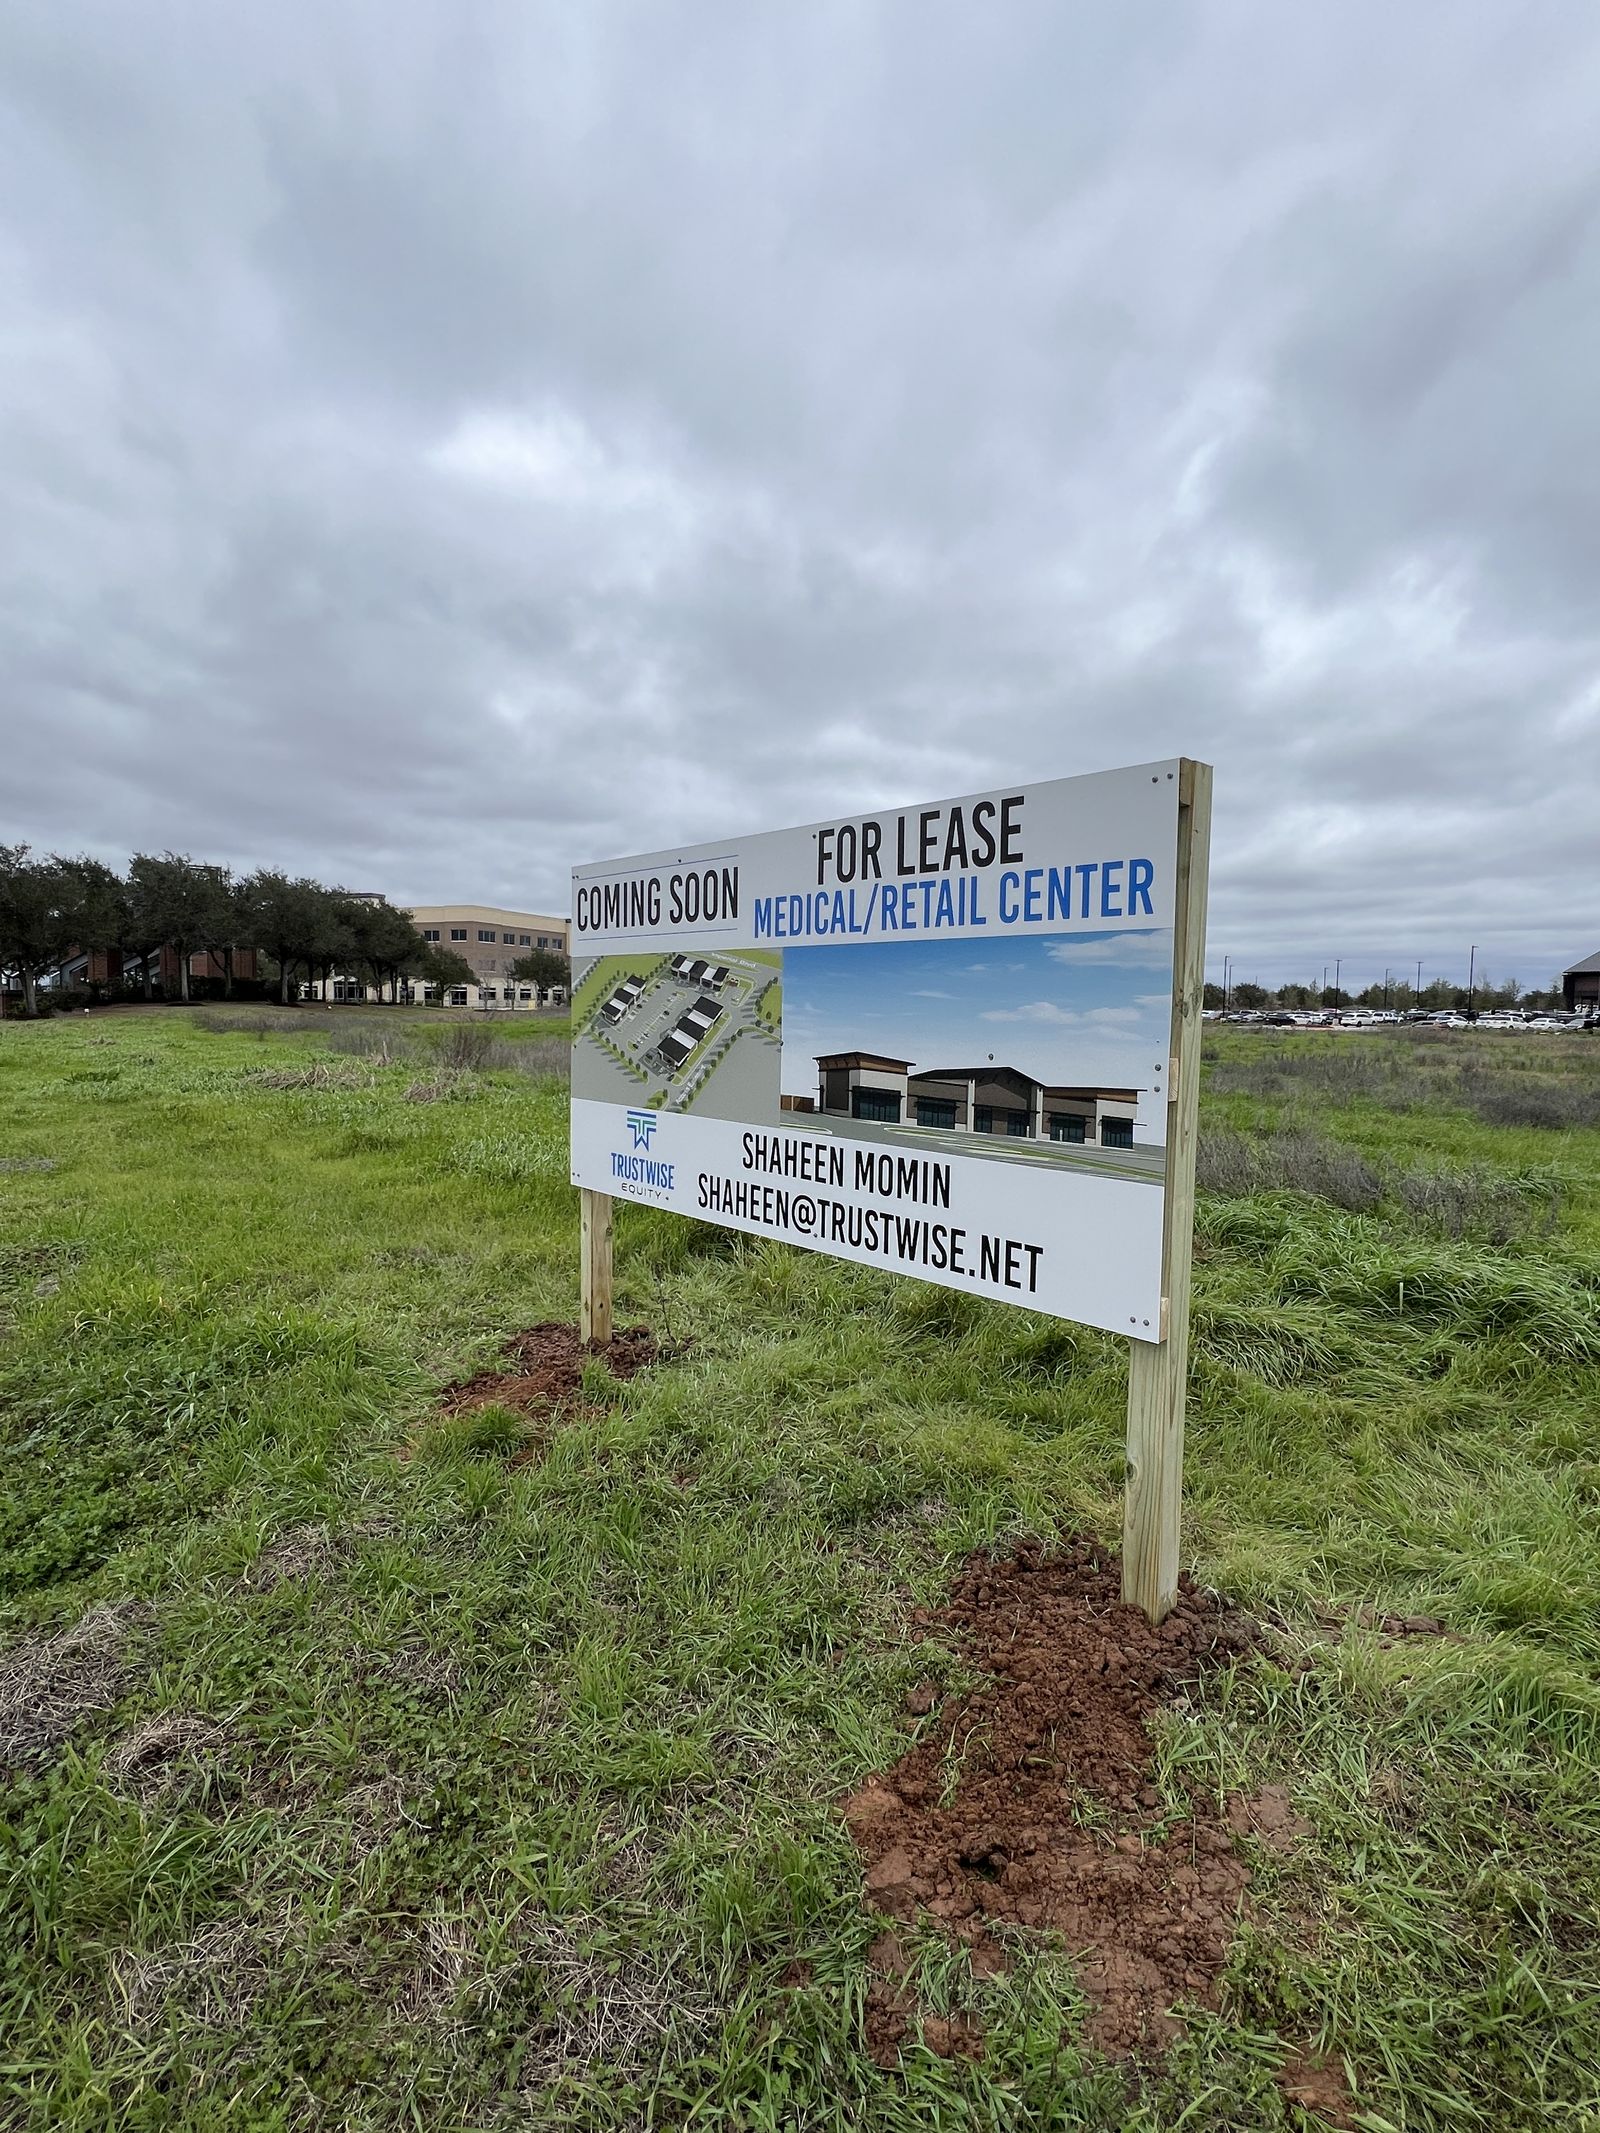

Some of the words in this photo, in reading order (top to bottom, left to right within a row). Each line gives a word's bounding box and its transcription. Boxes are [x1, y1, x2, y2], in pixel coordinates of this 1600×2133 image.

[817, 821, 882, 884] FOR
[897, 796, 1024, 876] LEASE
[577, 877, 661, 932] COMING
[669, 866, 739, 924] SOON
[754, 876, 986, 938] MEDICAL/RETAIL
[1000, 858, 1154, 924] CENTER
[611, 1152, 675, 1190] TRUSTWISE
[621, 1182, 662, 1200] EQUITY
[742, 1132, 844, 1187] SHAHEEN
[855, 1151, 950, 1208] MOMIN
[698, 1173, 1044, 1293] SHAHEEN@TRUSTWISE.NET
